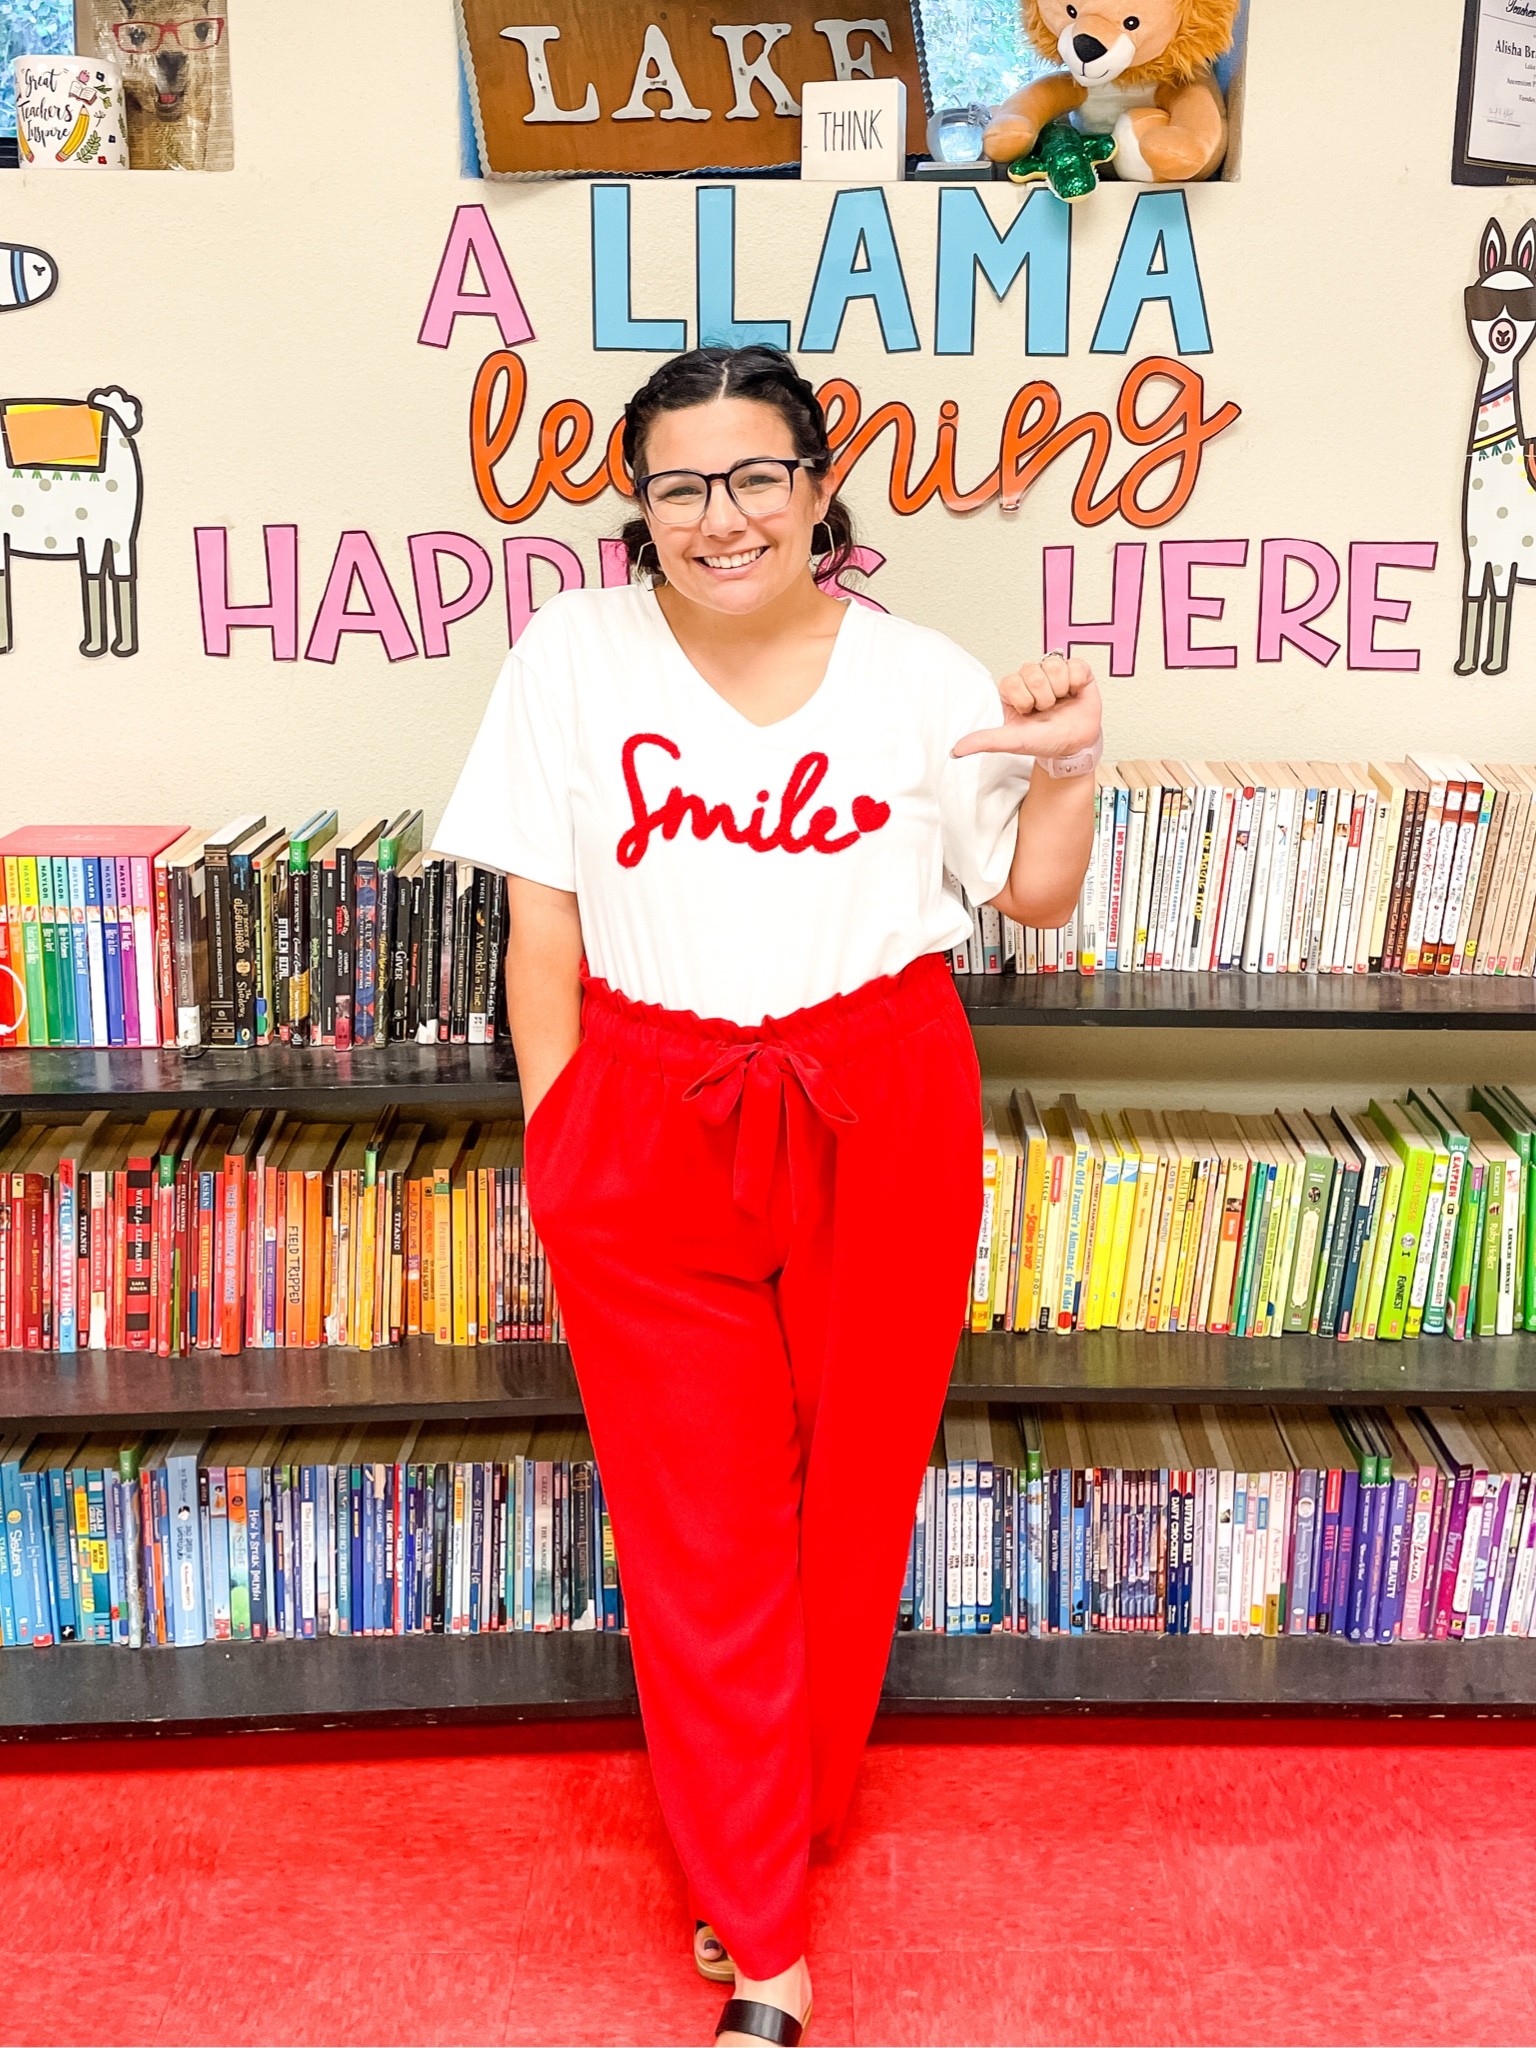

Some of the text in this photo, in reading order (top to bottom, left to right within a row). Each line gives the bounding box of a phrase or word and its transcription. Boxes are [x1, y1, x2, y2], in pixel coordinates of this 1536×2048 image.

[1494, 39, 1522, 57] Alisha
[499, 18, 892, 122] LAKE
[818, 109, 883, 152] THINK
[417, 183, 1215, 357] A LLAMA
[469, 349, 1242, 528] lening
[1043, 538, 1438, 676] HERE
[617, 733, 861, 869] Smile
[1116, 831, 1124, 847] MR.
[1203, 831, 1213, 851] The
[1401, 837, 1409, 851] Eddie
[1412, 836, 1420, 851] Eddie
[1423, 838, 1436, 862] Wimpy
[1101, 838, 1110, 878] TOUCHING
[1113, 850, 1123, 892] POPPER'S
[1198, 852, 1211, 890] Magic
[1289, 859, 1298, 876] BEST
[1422, 864, 1434, 876] Kid
[87, 865, 95, 899] NAYLOR
[1099, 880, 1107, 908] SPIRIT
[1153, 869, 1162, 905] CHOCOLATE
[1161, 869, 1171, 905] CHOCOLATE
[1170, 896, 1179, 923] CONTROL
[1283, 907, 1291, 922] YEAR
[1282, 923, 1290, 940] EVER
[215, 949, 223, 972] PECULIAR
[278, 918, 289, 980] STOLEN GIRL
[475, 941, 484, 975] Wrinkle
[394, 950, 407, 980] GIVER
[236, 982, 247, 1017] Shadows
[474, 985, 484, 1006] Time
[1042, 1170, 1050, 1201] CREECH
[410, 1200, 418, 1223] JUDY
[1160, 1166, 1176, 1242] LORD handful
[133, 1189, 144, 1272] WATER for ELEPHANTS
[225, 1185, 237, 1304] THE TRADING GAME
[1062, 1150, 1088, 1309] The Old Farmer's Almanac for Kids
[1441, 1228, 1451, 1259] CREATURE
[1488, 1223, 1498, 1243] Ruby
[61, 1190, 72, 1326] TELL ME EVERYTHING
[201, 1240, 209, 1269] WESTING
[288, 1226, 300, 1304] FIELD TRIPPED
[437, 1221, 448, 1290] Becoming Naomi
[1034, 1254, 1042, 1275] THAT
[977, 1273, 987, 1298] KINNEY
[1032, 1278, 1040, 1296] DOG
[1394, 1276, 1406, 1310] FUNNIEST
[1061, 1473, 1069, 1507] BUNTING
[304, 1507, 312, 1519] The
[1061, 1515, 1069, 1532] THE
[1417, 1515, 1428, 1541] DORK
[55, 1522, 67, 1558] PHANTOM
[1170, 1496, 1179, 1568] DAVY CROCKETT
[1183, 1498, 1192, 1563] BUFFALO BILL
[1324, 1524, 1335, 1551] HOLES
[1341, 1526, 1351, 1552] HOLES
[1386, 1483, 1405, 1599] SEWELL BLACK BEAUTY
[10, 1529, 23, 1577] Sisters
[1075, 1542, 1082, 1551] To
[304, 1562, 312, 1587] Doors
[1061, 1571, 1068, 1581] OF
[1473, 1558, 1488, 1592] ARF
[304, 1589, 312, 1612] Down
[1061, 1584, 1069, 1608] RILEY
